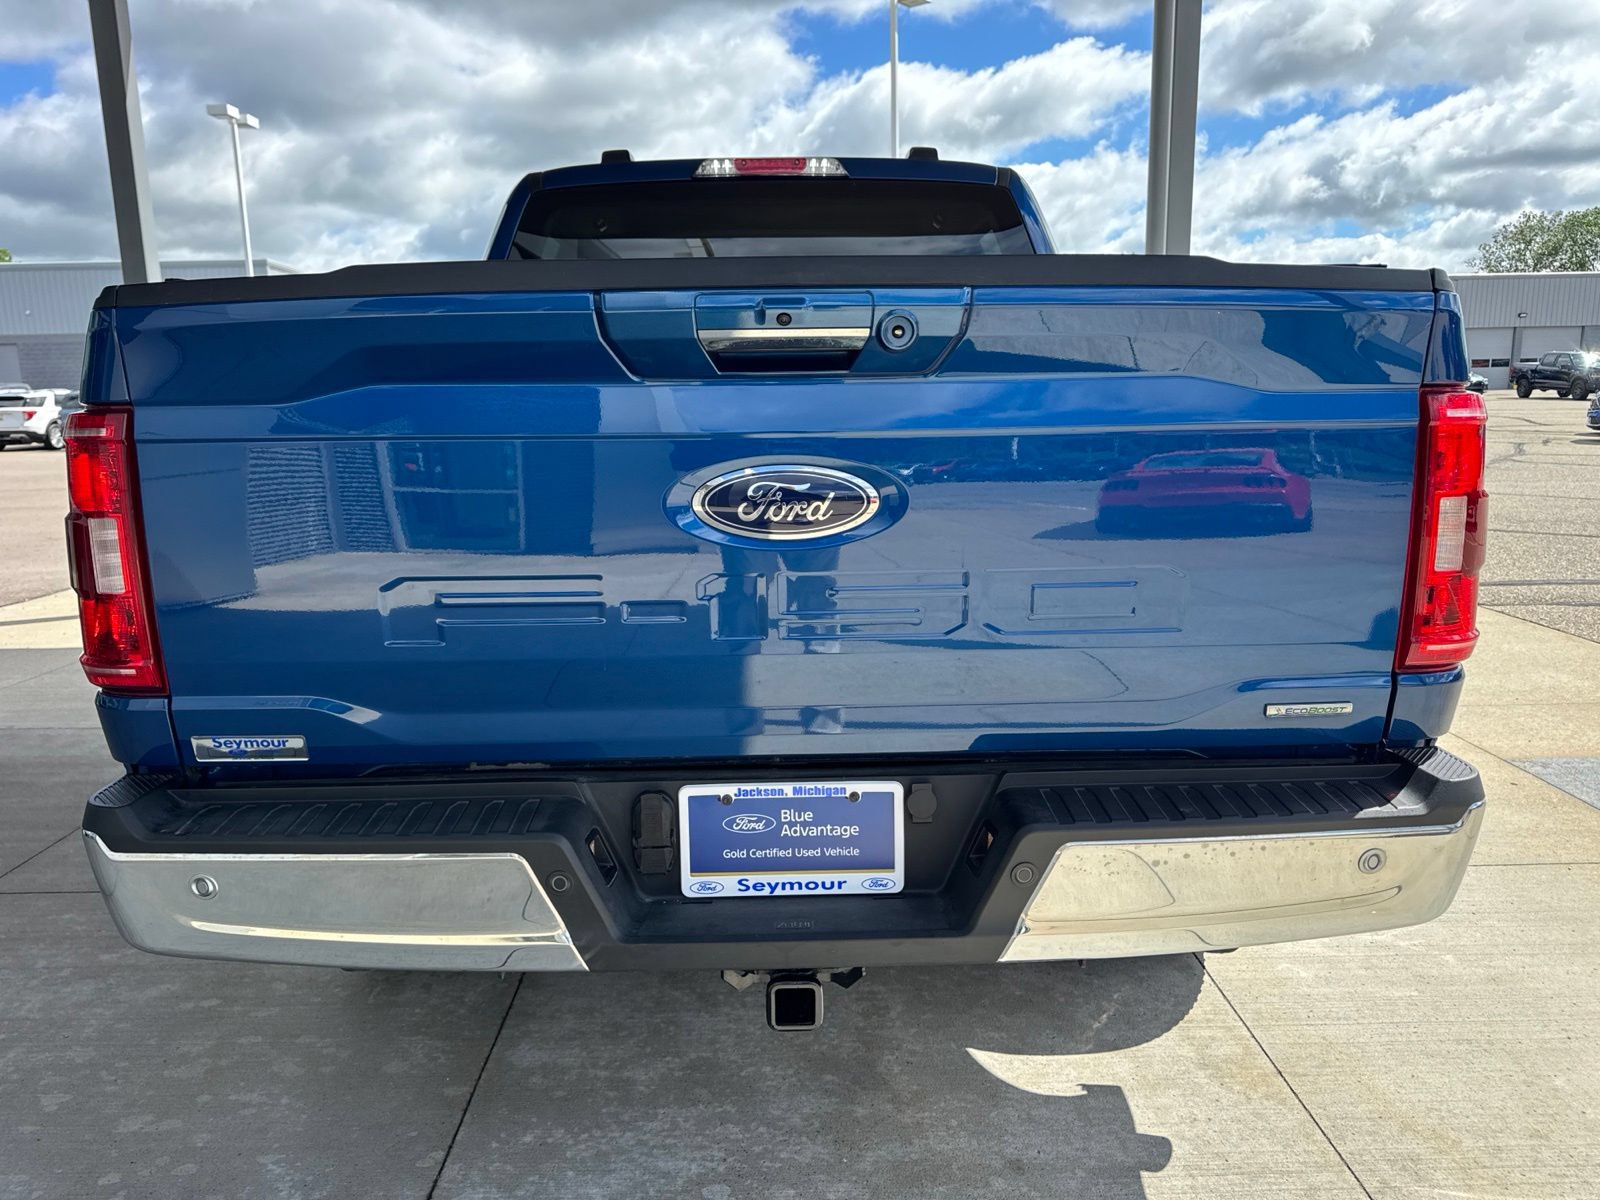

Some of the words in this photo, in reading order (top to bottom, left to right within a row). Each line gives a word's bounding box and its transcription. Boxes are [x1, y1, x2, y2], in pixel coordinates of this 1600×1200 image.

[737, 481, 835, 522] Ford
[211, 736, 288, 750] Seymour
[792, 785, 847, 797] Michigan
[780, 809, 813, 822] Blue
[732, 817, 766, 830] Ford
[780, 823, 860, 838] Advantage
[723, 849, 746, 858] Gold
[749, 847, 792, 858] Certified
[795, 847, 821, 857] Used
[823, 846, 860, 857] Vehicle
[737, 879, 847, 894] Seymour
